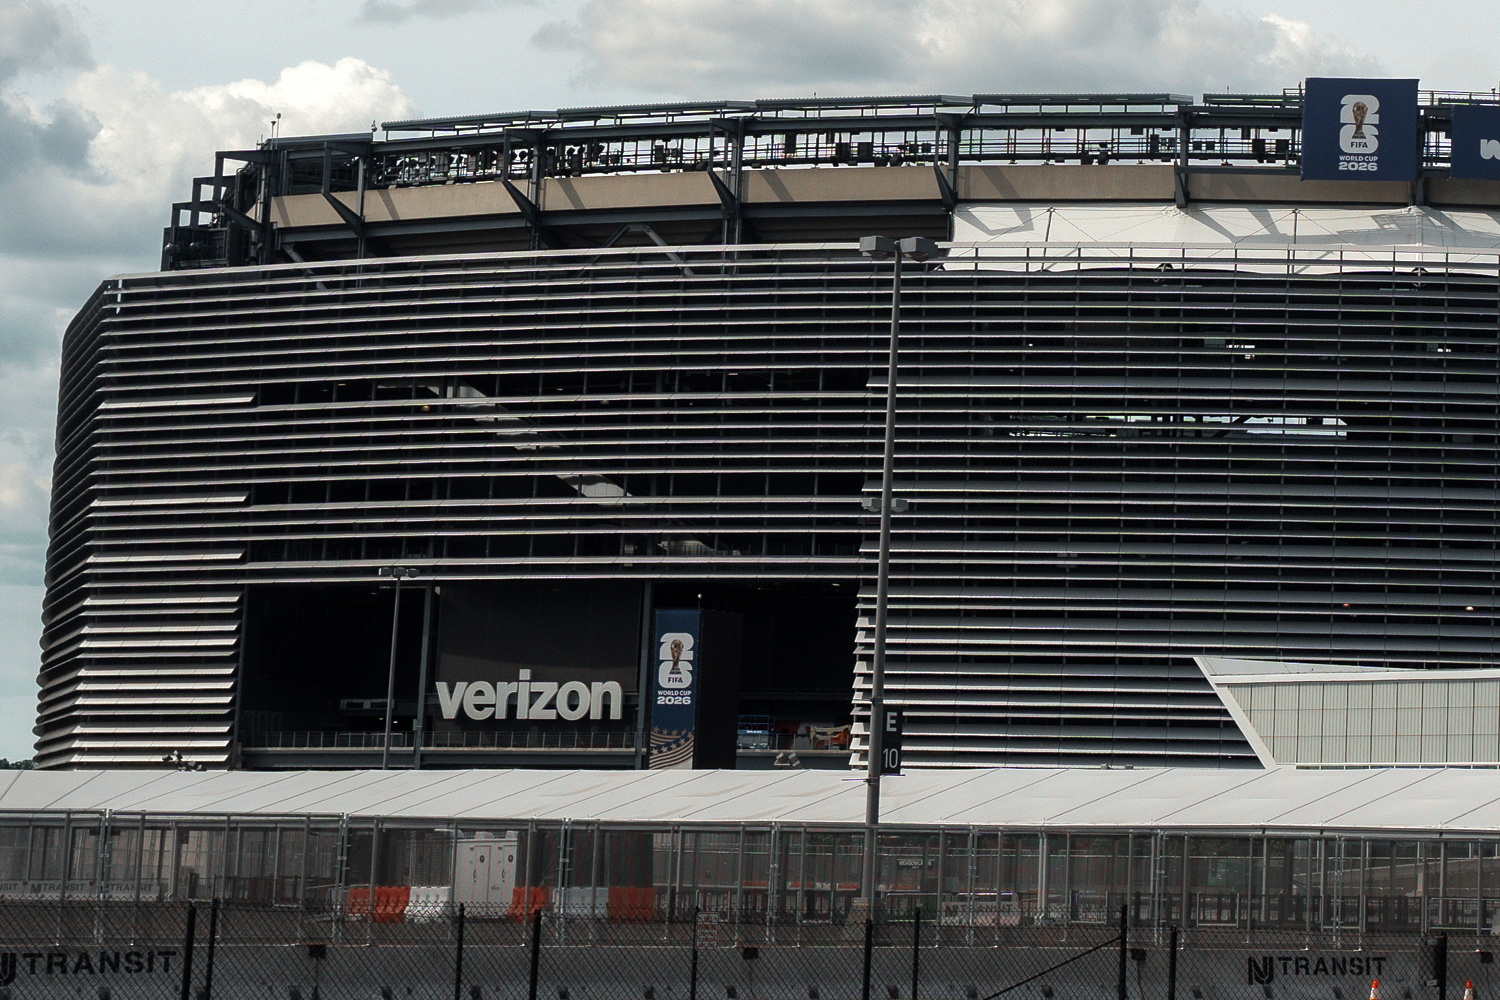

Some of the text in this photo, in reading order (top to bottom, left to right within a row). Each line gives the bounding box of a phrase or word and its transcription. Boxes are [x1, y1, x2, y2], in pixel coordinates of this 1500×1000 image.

[1350, 141, 1368, 149] FIFA
[1338, 161, 1378, 171] 2026
[667, 676, 683, 684] FIFA
[435, 668, 623, 721] verizon
[656, 696, 692, 705] 2026
[886, 711, 898, 732] E
[882, 747, 899, 769] 10
[23, 951, 177, 975] TRANSIT
[1248, 956, 1387, 985] NJ TRANSIT
